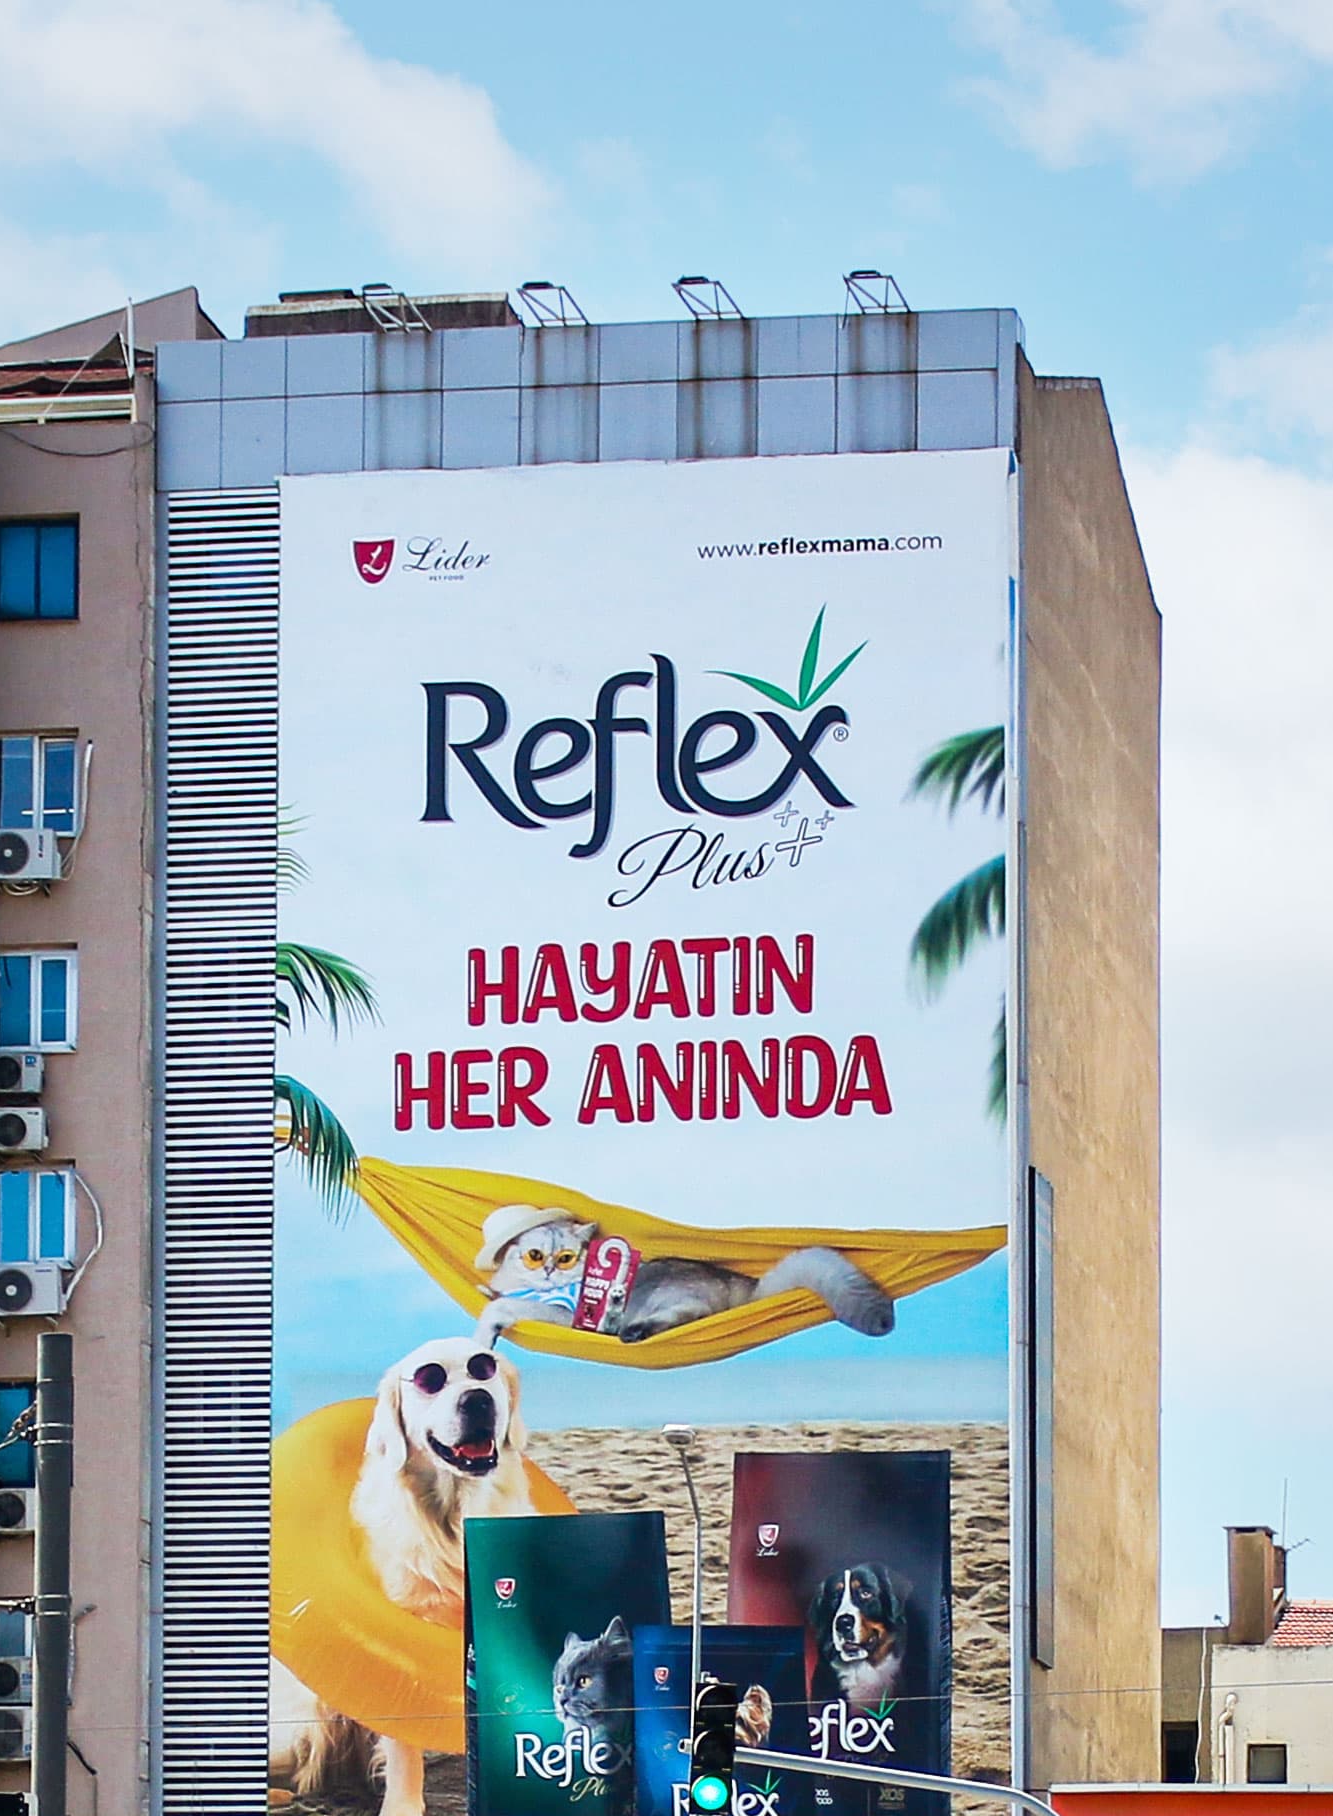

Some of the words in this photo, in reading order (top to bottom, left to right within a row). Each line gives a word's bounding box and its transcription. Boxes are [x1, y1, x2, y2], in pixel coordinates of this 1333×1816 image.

[402, 535, 491, 572] Lider
[696, 531, 944, 561] www.reflexmama.com
[420, 653, 858, 858] Reflex
[467, 933, 815, 1027] HAYATIN
[394, 1046, 551, 1131] HER
[577, 1034, 893, 1125] ANINDA
